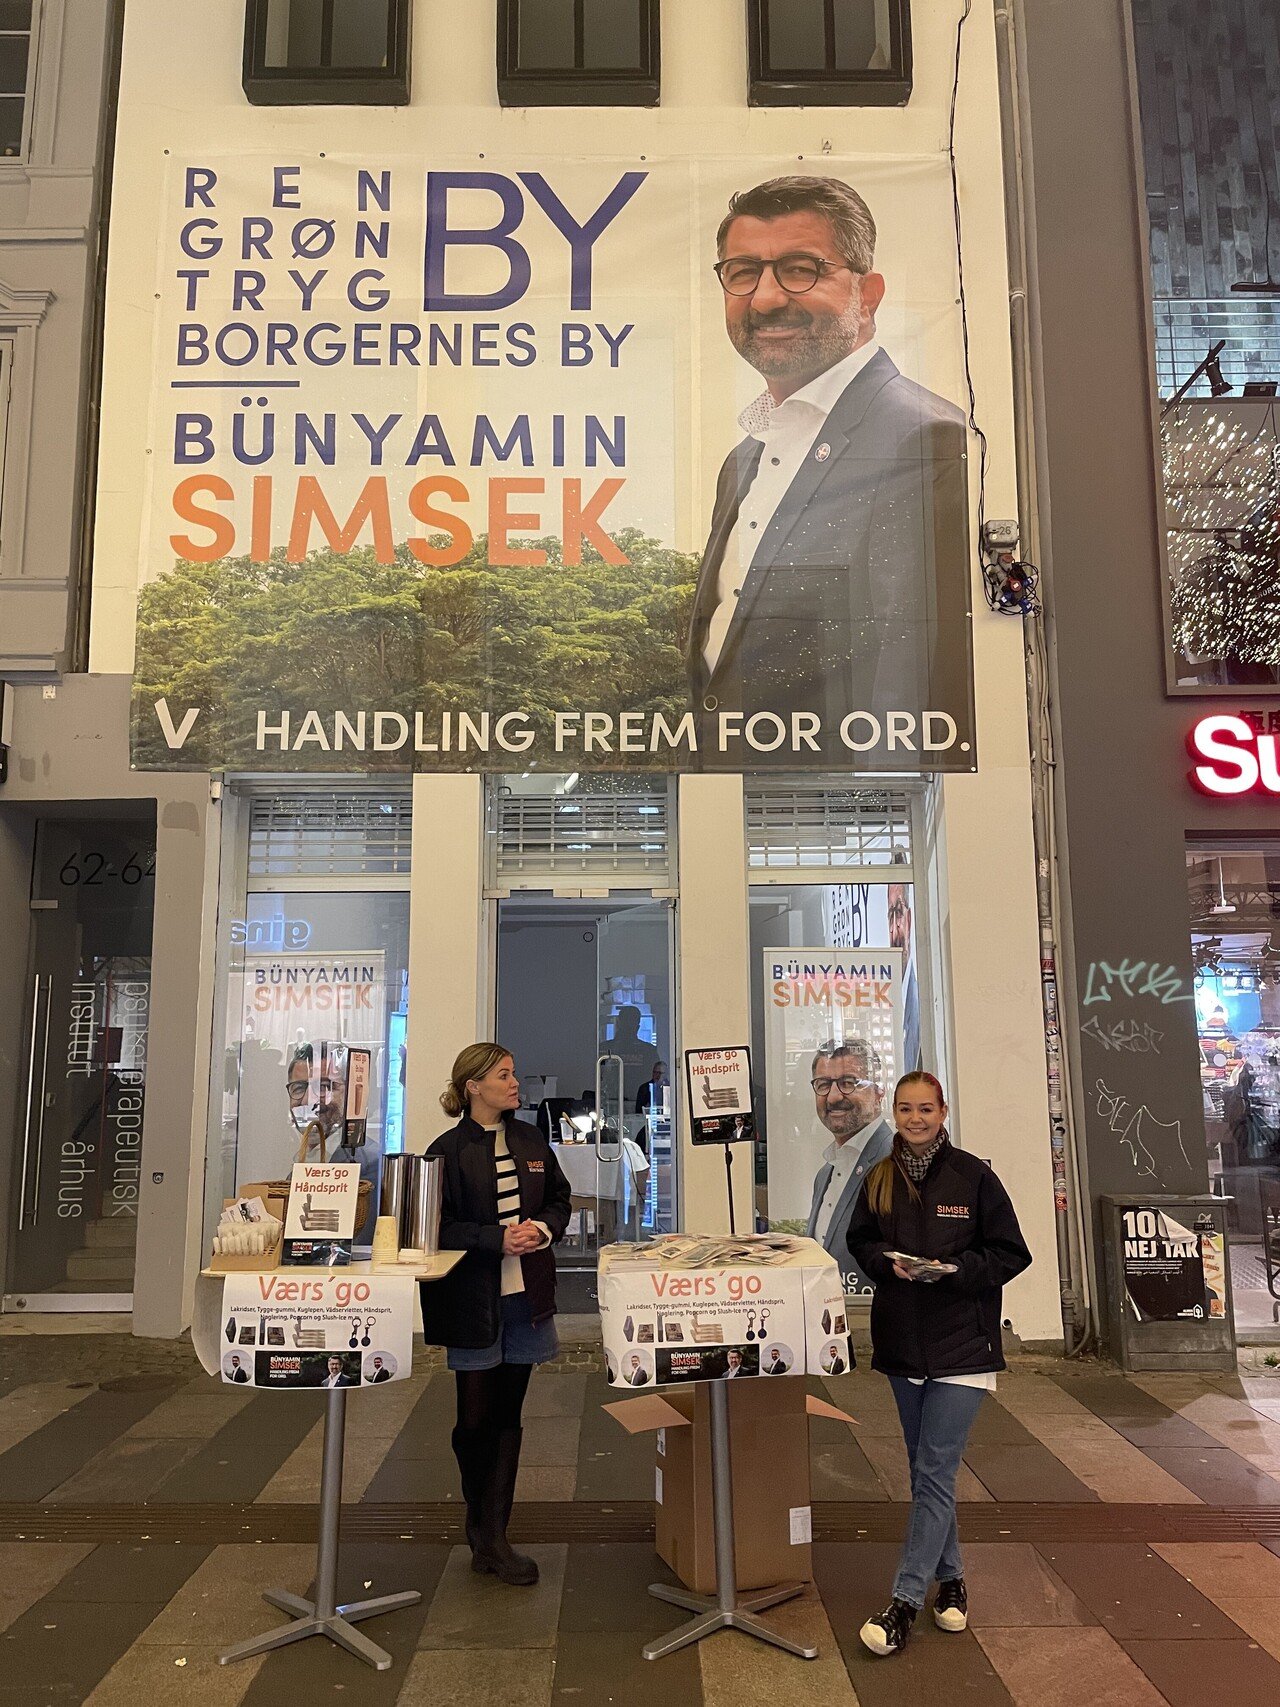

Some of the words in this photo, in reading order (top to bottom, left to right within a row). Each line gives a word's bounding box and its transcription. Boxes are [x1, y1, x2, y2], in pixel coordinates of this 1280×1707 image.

[184, 166, 391, 212] REN
[180, 218, 390, 260] GRØN
[424, 171, 650, 311] BY
[177, 269, 391, 312] TRYG
[177, 322, 538, 367] BORGERNES
[560, 324, 635, 368] BY
[174, 396, 626, 467] BÜNYAMIN
[169, 474, 632, 567] SIMSEK
[256, 710, 536, 752] HANDLING
[554, 711, 698, 753] FREM
[718, 710, 822, 752] FOR
[839, 710, 971, 752] ORD.
[255, 965, 374, 984] BÜNYAMIN
[772, 960, 892, 980] BÜNYAMIN
[254, 985, 374, 1012] SIMSEK
[773, 981, 894, 1008] SIMSEK
[66, 983, 104, 1079] institut
[692, 1062, 740, 1076] Håndsprit
[295, 1182, 348, 1194] Håndsprit
[937, 1205, 970, 1215] SIMSEK
[1124, 1240, 1157, 1258] NEJ
